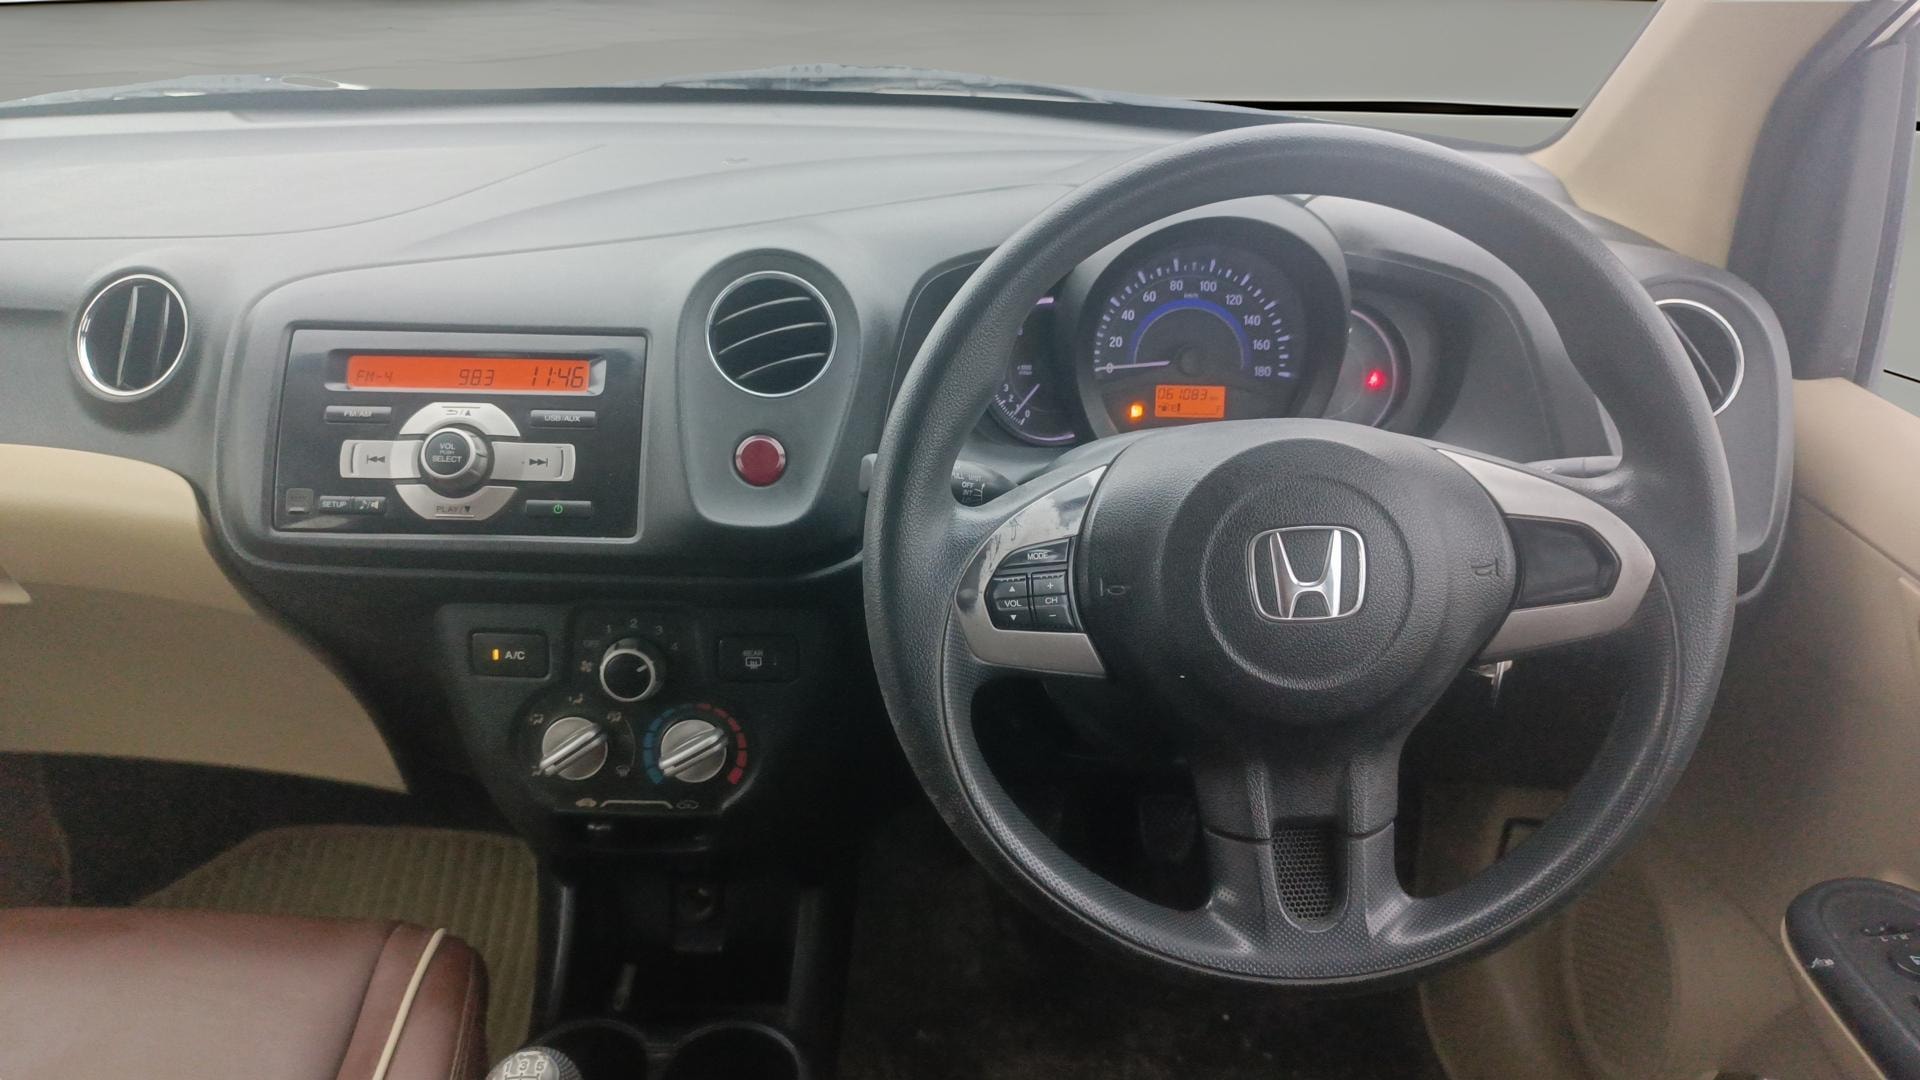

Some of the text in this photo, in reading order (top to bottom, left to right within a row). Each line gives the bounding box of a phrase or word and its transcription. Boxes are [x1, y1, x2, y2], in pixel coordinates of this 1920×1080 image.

[1170, 281, 1183, 291] 80
[1200, 281, 1217, 292] 100
[1143, 291, 1156, 302] 60
[1225, 294, 1243, 305] 120
[1121, 310, 1135, 321] 40
[1244, 315, 1261, 326] 140
[1109, 336, 1123, 348] 20
[1253, 339, 1270, 350] 160
[1254, 366, 1271, 377] 180
[356, 367, 584, 388] FM-4 983 11:46
[439, 443, 456, 451] VOL
[432, 455, 463, 463] SELECT
[630, 618, 638, 628] 2
[656, 625, 663, 635] 3
[505, 650, 525, 660] A/C
[520, 1061, 528, 1071] 3
